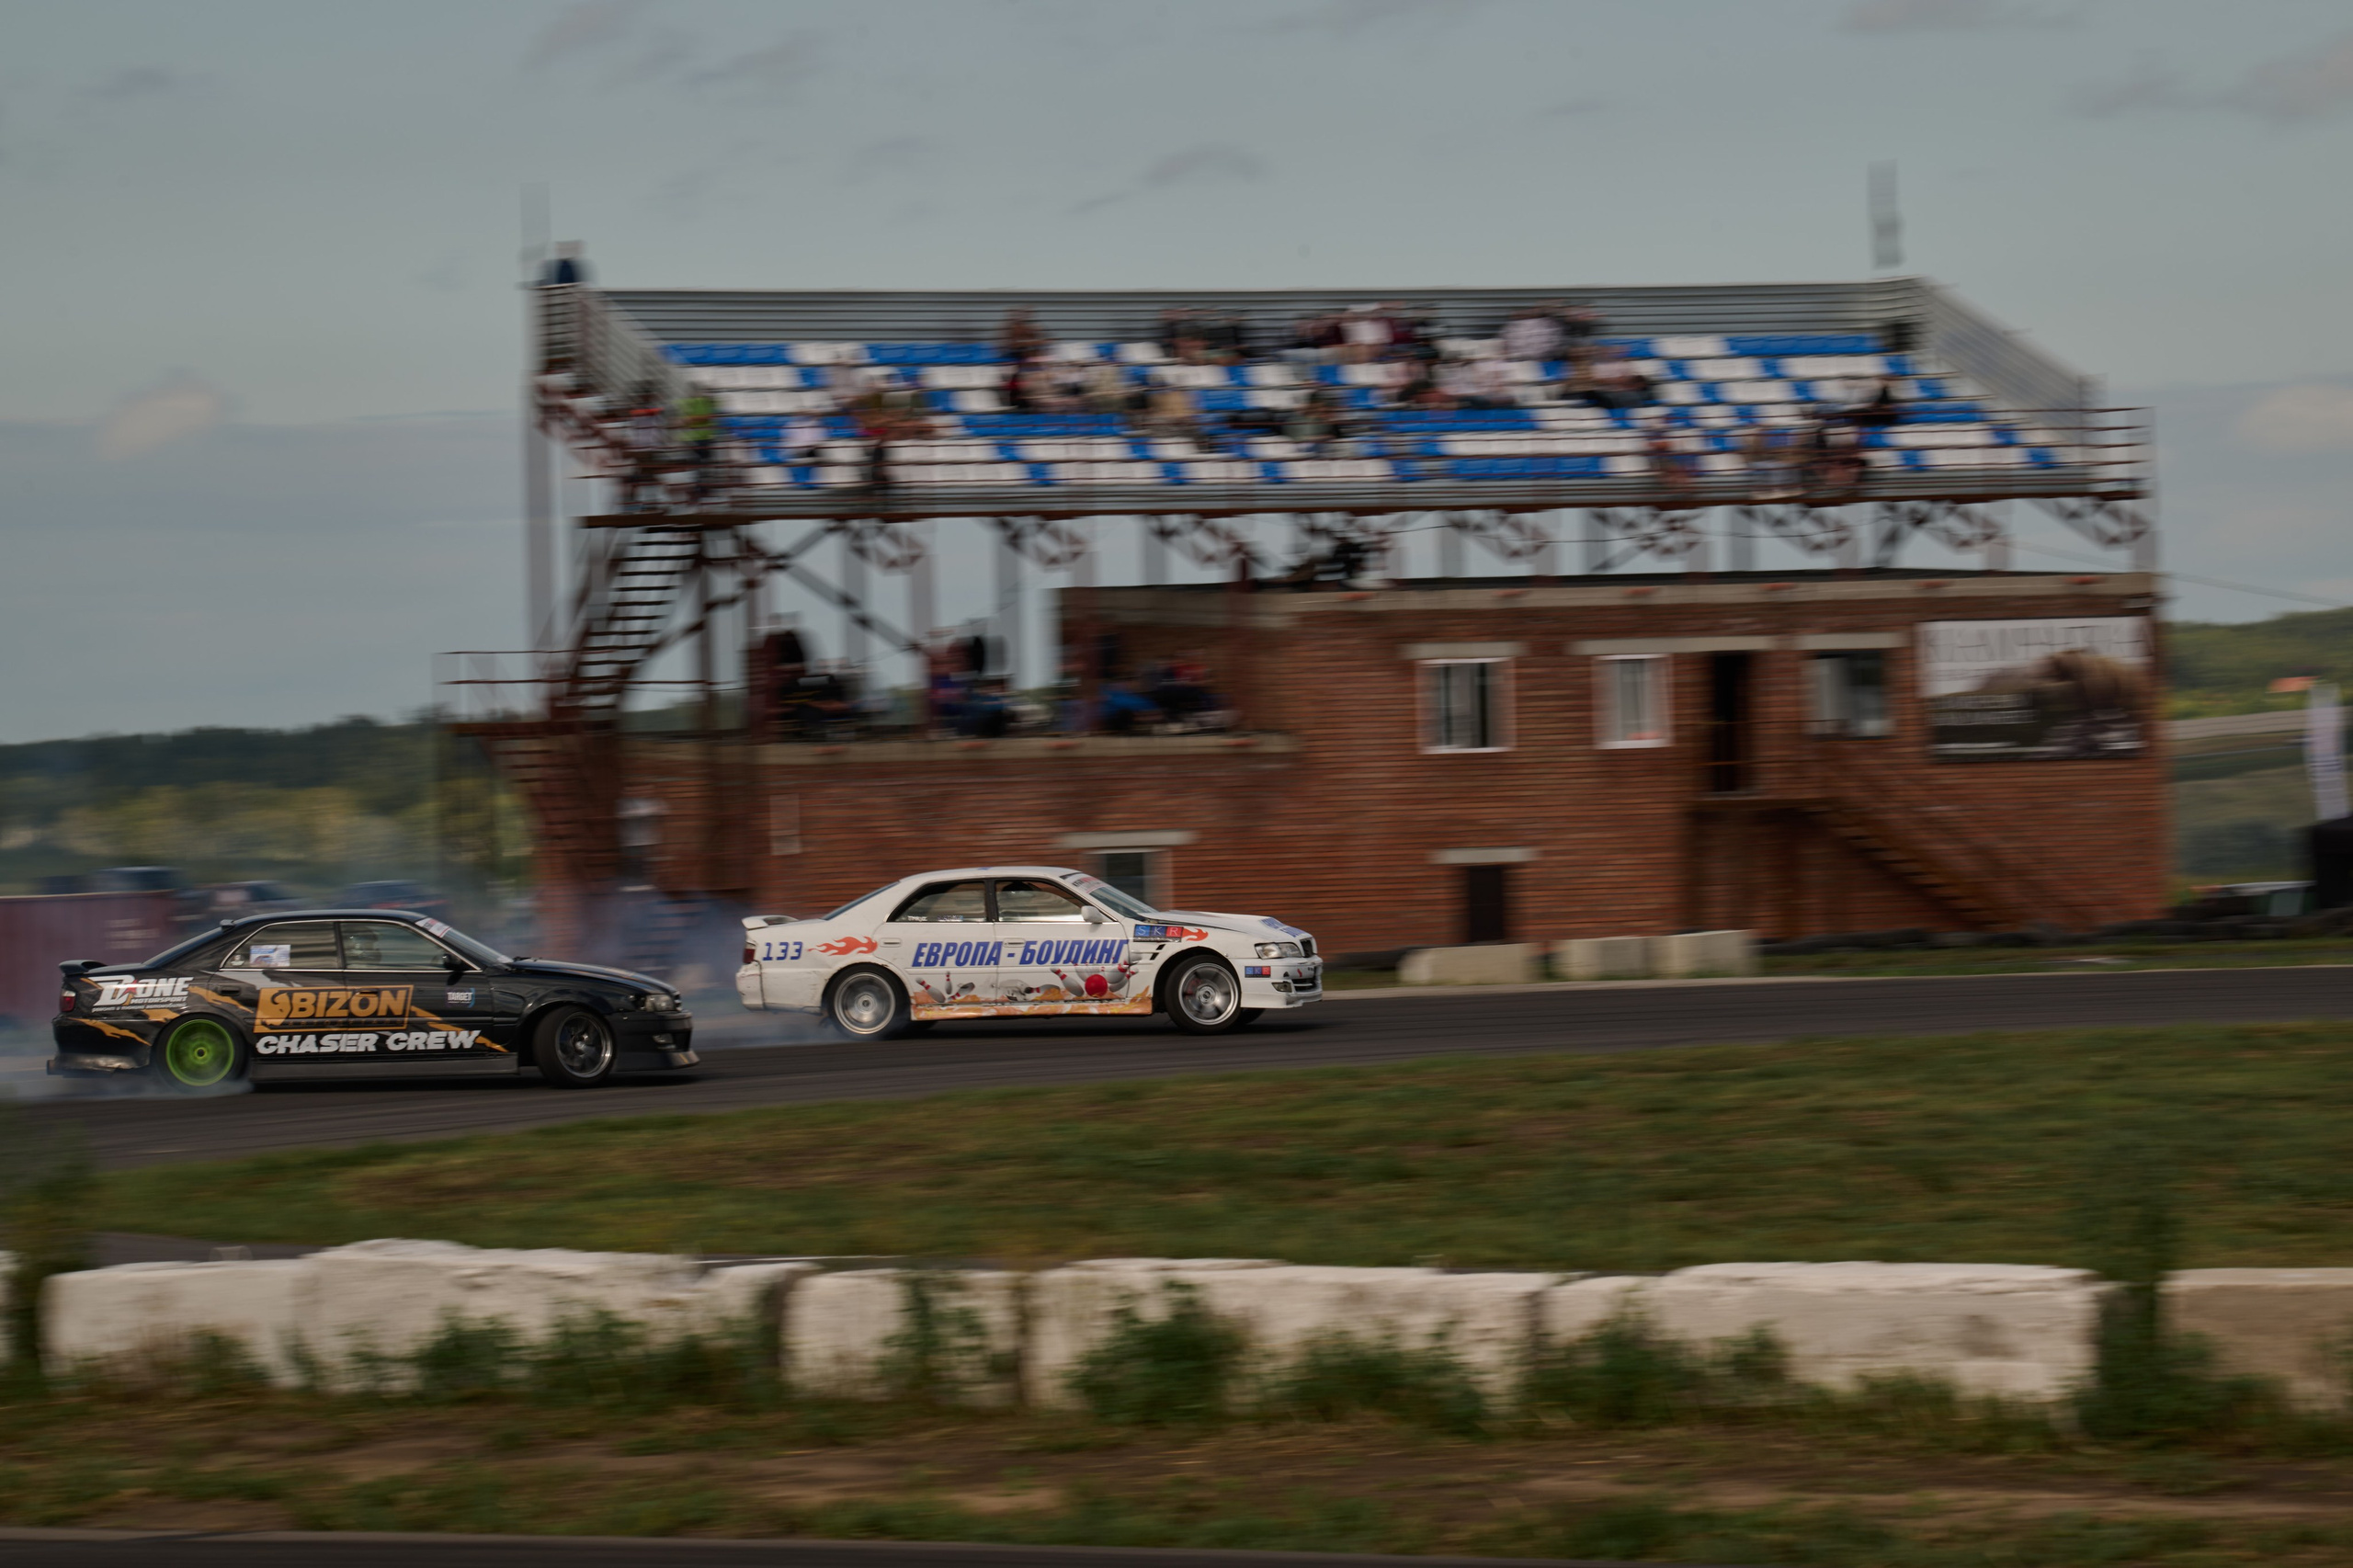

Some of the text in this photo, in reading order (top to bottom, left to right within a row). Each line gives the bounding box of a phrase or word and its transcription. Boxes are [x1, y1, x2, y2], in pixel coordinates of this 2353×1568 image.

[1137, 925, 1179, 937] SKR
[762, 941, 802, 960] 133
[912, 941, 1003, 967] ЕВРОПА
[1018, 939, 1129, 965] БОУЛИНГ
[130, 995, 188, 1004] MOTORSPORT
[289, 989, 407, 1017] BIZON
[256, 1030, 481, 1054] CHASER CREW
